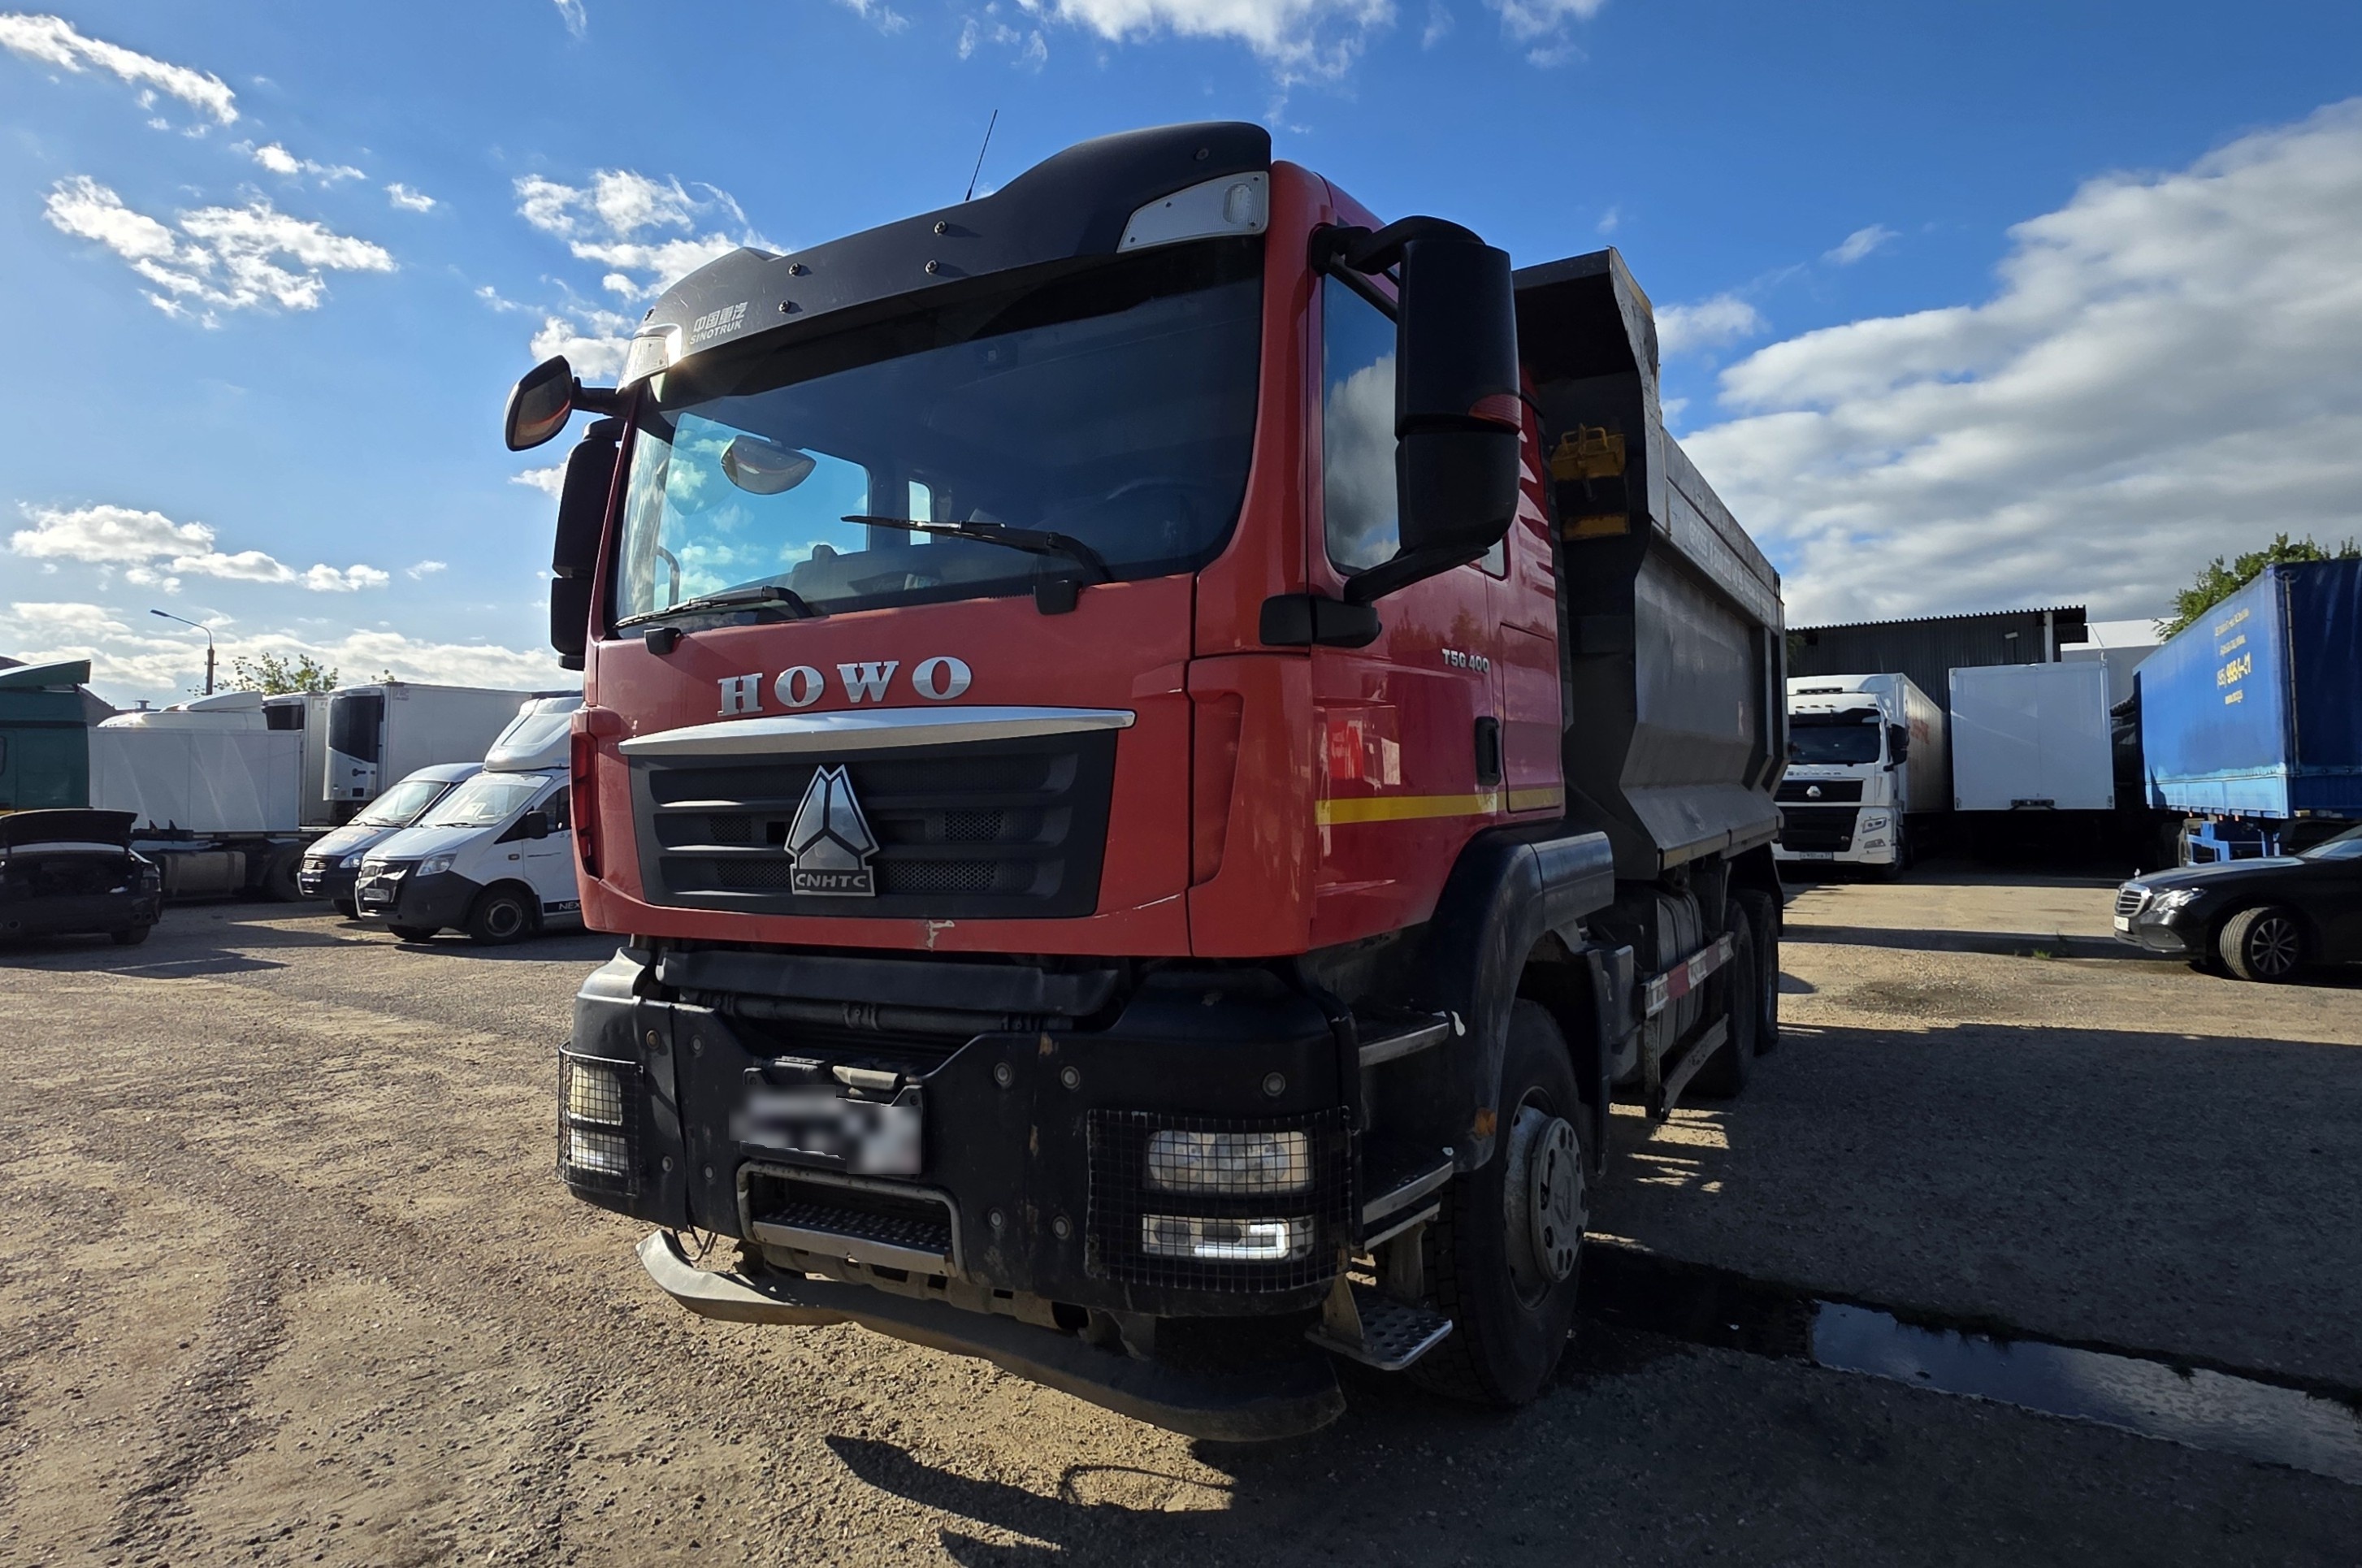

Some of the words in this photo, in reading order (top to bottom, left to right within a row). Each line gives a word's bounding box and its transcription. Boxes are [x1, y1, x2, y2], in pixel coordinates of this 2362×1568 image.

[693, 301, 748, 332] 中国重汽
[689, 319, 743, 345] SINOTRUK
[1441, 648, 1467, 669] T5G
[1468, 655, 1490, 674] 400
[717, 656, 972, 717] HOWO
[795, 873, 867, 888] CNHTC
